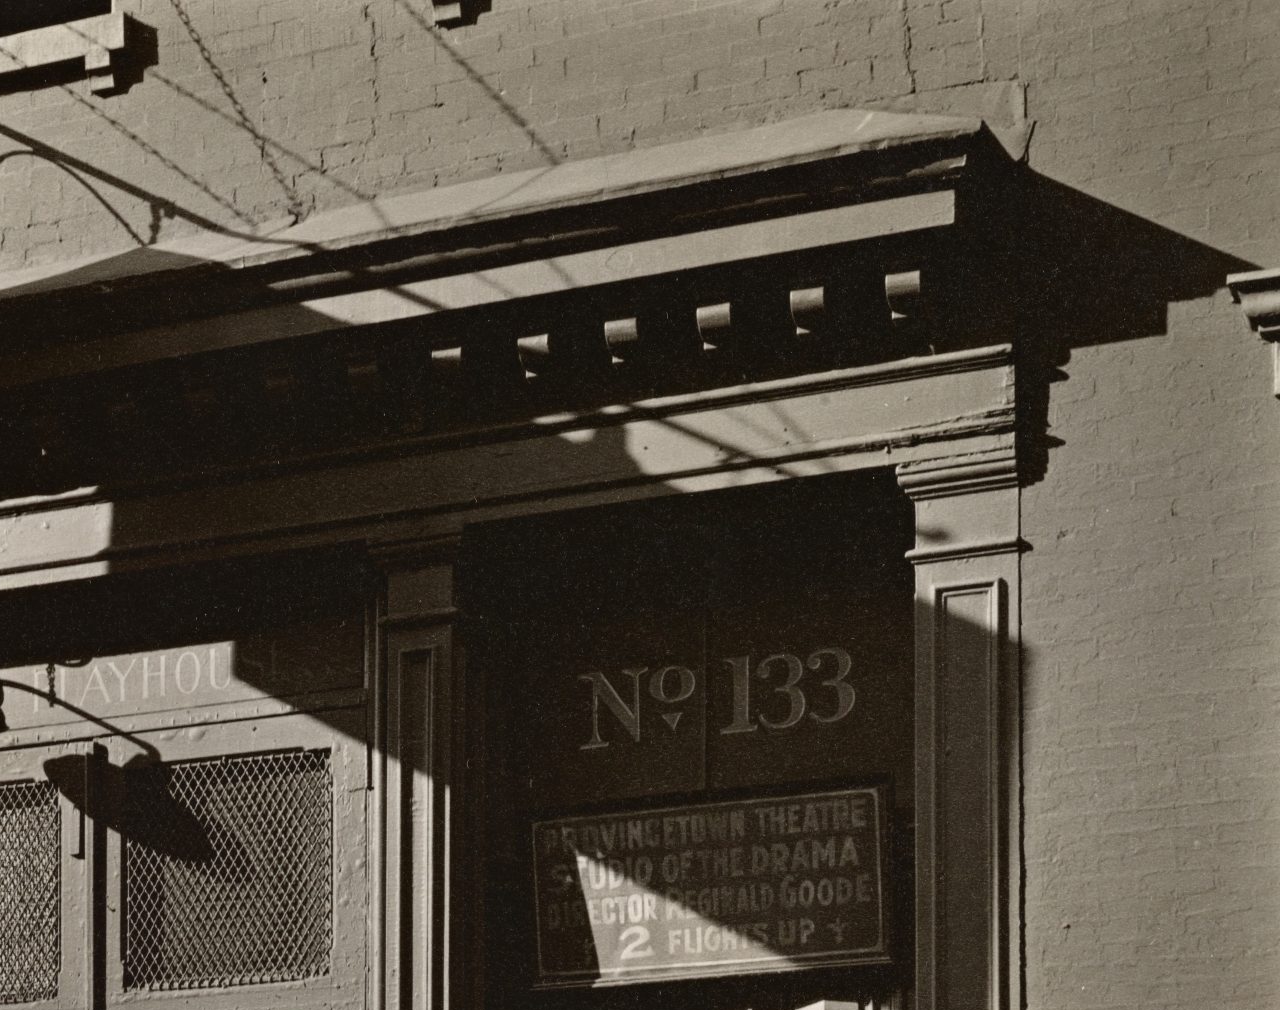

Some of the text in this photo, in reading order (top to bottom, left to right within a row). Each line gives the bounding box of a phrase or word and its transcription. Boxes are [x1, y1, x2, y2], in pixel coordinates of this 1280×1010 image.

[33, 645, 276, 714] PLAYHOU
[720, 646, 857, 736] 133
[545, 799, 868, 853] PROVINCETOWN THEATRE
[550, 835, 860, 895] STUDIO OF THE DRAMA
[547, 891, 658, 930] DIRECTOR
[780, 873, 872, 908] GOODE
[620, 917, 815, 960] 2 FLIGHTS UP
